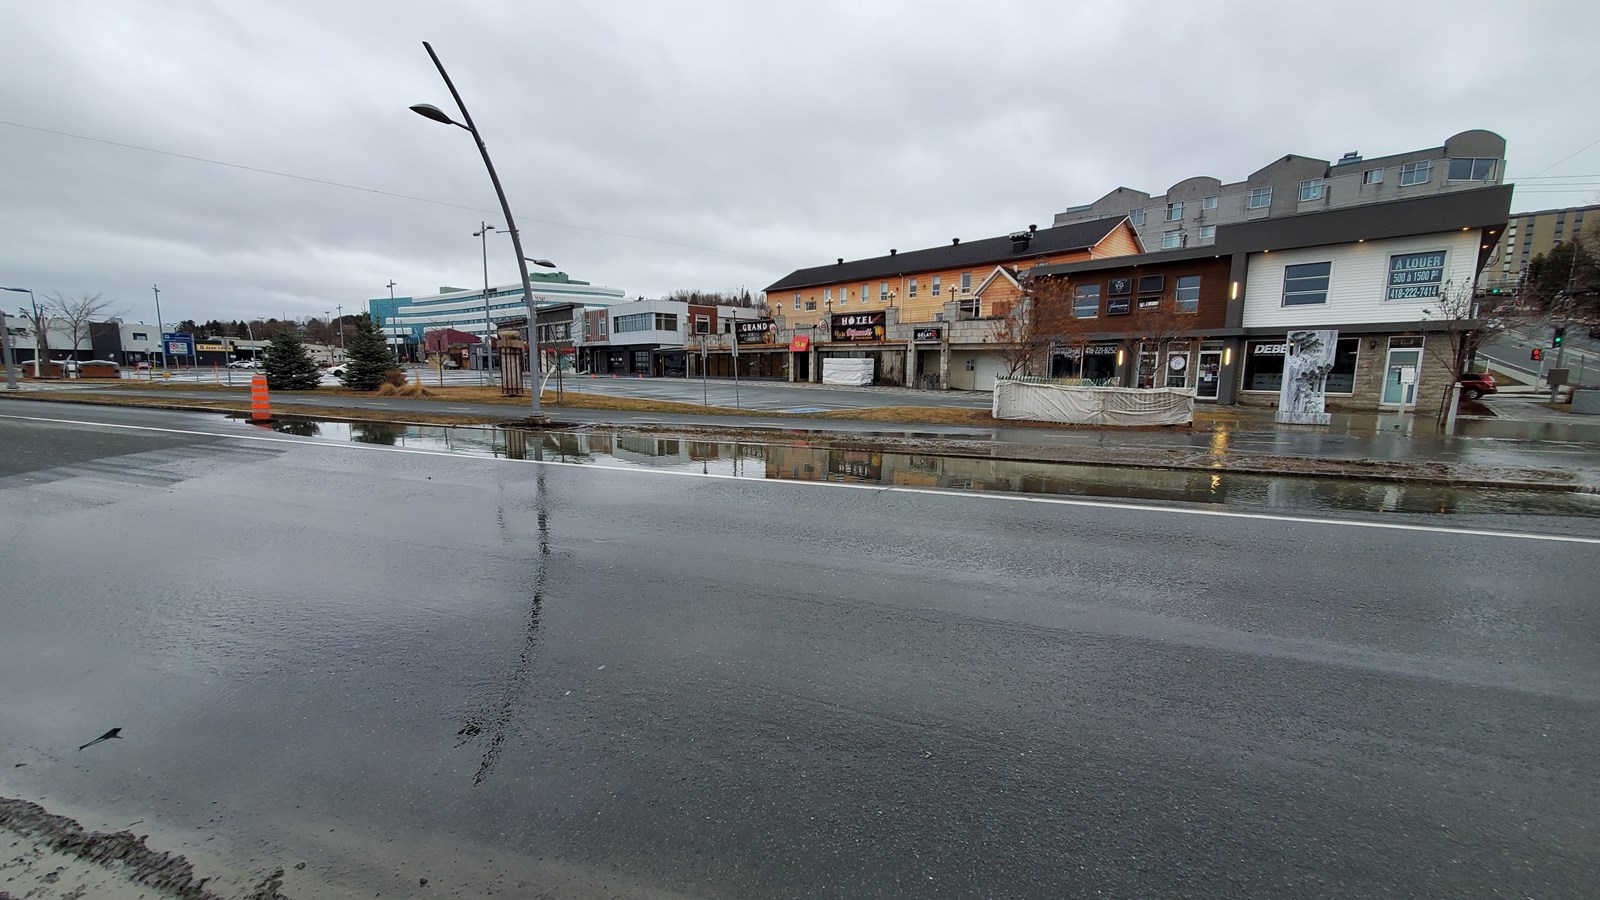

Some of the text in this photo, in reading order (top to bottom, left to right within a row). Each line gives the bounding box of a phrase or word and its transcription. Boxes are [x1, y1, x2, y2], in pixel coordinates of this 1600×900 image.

[1406, 256, 1441, 268] LOUER
[1393, 273, 1405, 283] 500
[1413, 270, 1430, 282] 1500
[1391, 287, 1437, 298] 418-222-7414
[742, 322, 768, 332] GRAND
